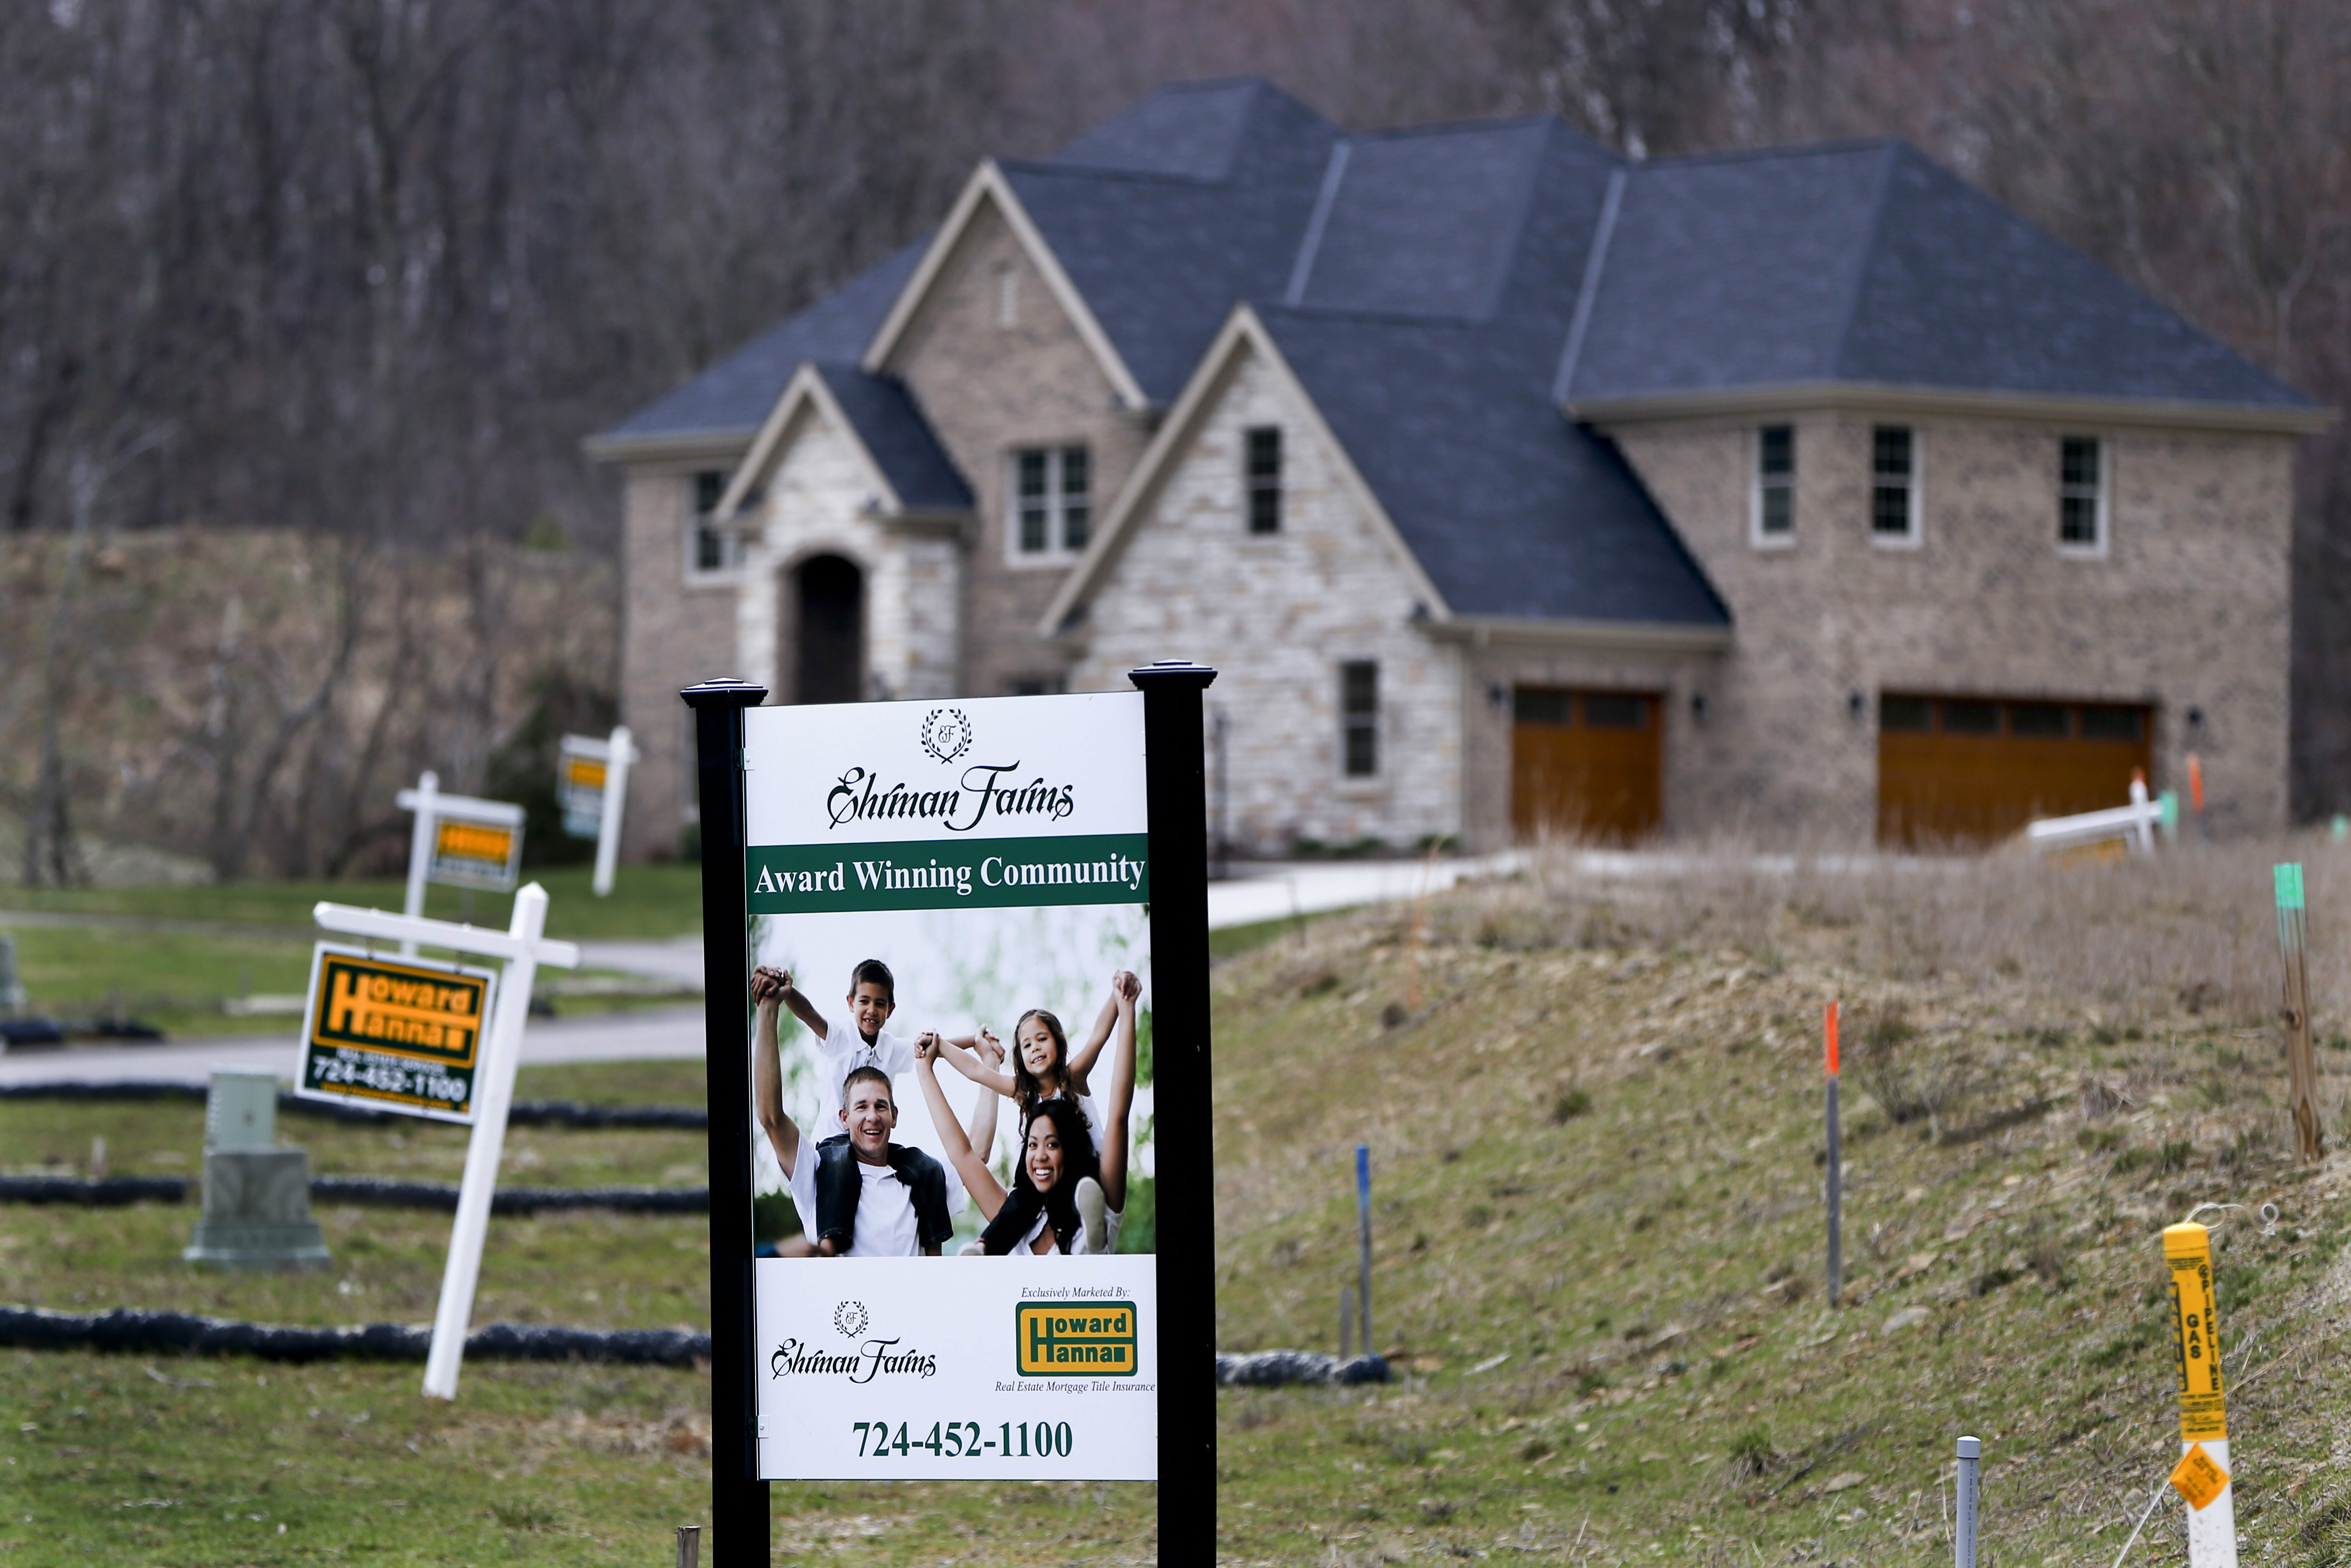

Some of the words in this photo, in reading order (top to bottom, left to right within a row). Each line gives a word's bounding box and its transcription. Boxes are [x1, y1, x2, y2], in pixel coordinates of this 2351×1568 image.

[828, 766, 959, 830] Ehrman
[944, 759, 1074, 831] Farms
[754, 862, 845, 894] Award
[853, 859, 973, 896] Winning
[981, 853, 1146, 891] Community
[328, 969, 473, 1016] Howard
[312, 1054, 467, 1102] 724-452-1100
[1021, 1287, 1070, 1300] Exclusively
[1072, 1287, 1113, 1297] Marketed
[1116, 1287, 1130, 1299] By:
[1030, 1313, 1127, 1341] Howard
[2187, 1314, 2201, 1359] GAS
[2201, 1279, 2220, 1391] PIPELINE
[771, 1338, 860, 1380] Ehrman
[849, 1337, 936, 1384] Farms
[995, 1381, 1015, 1392] Real
[1017, 1382, 1044, 1392] Estate
[1046, 1382, 1088, 1394] Mortgage
[1091, 1381, 1110, 1391] Title
[1112, 1382, 1155, 1392] Insurance
[852, 1421, 1073, 1457] 724-452-1100
